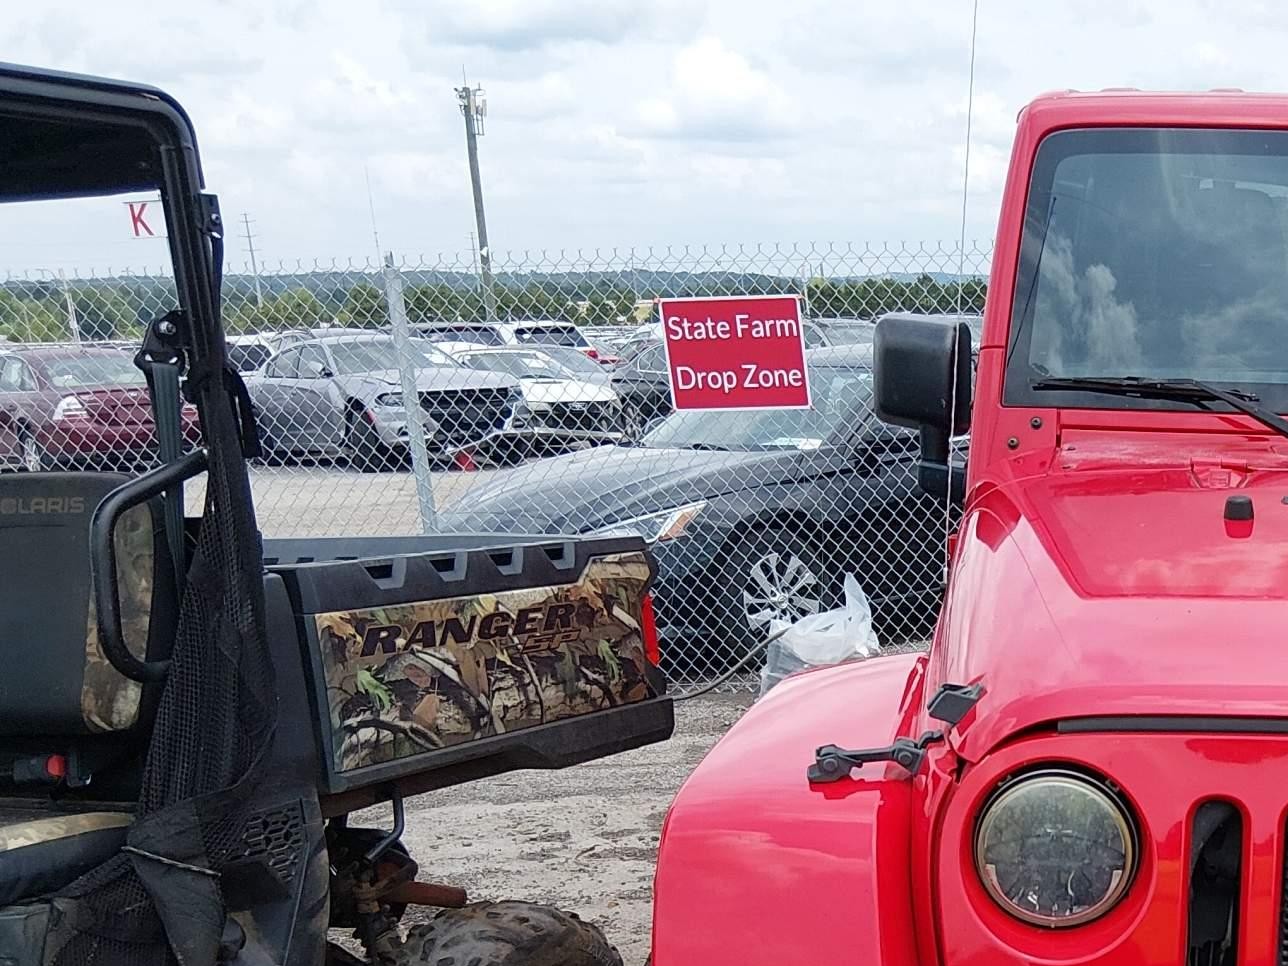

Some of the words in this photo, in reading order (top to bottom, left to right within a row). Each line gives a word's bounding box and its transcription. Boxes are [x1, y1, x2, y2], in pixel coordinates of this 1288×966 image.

[128, 202, 155, 237] K
[667, 315, 731, 341] State
[735, 314, 798, 338] Farm
[675, 365, 737, 394] Drop
[740, 364, 803, 389] Zone
[0, 498, 85, 513] OLARIS
[359, 602, 577, 659] RANGER
[520, 628, 582, 654] SP
